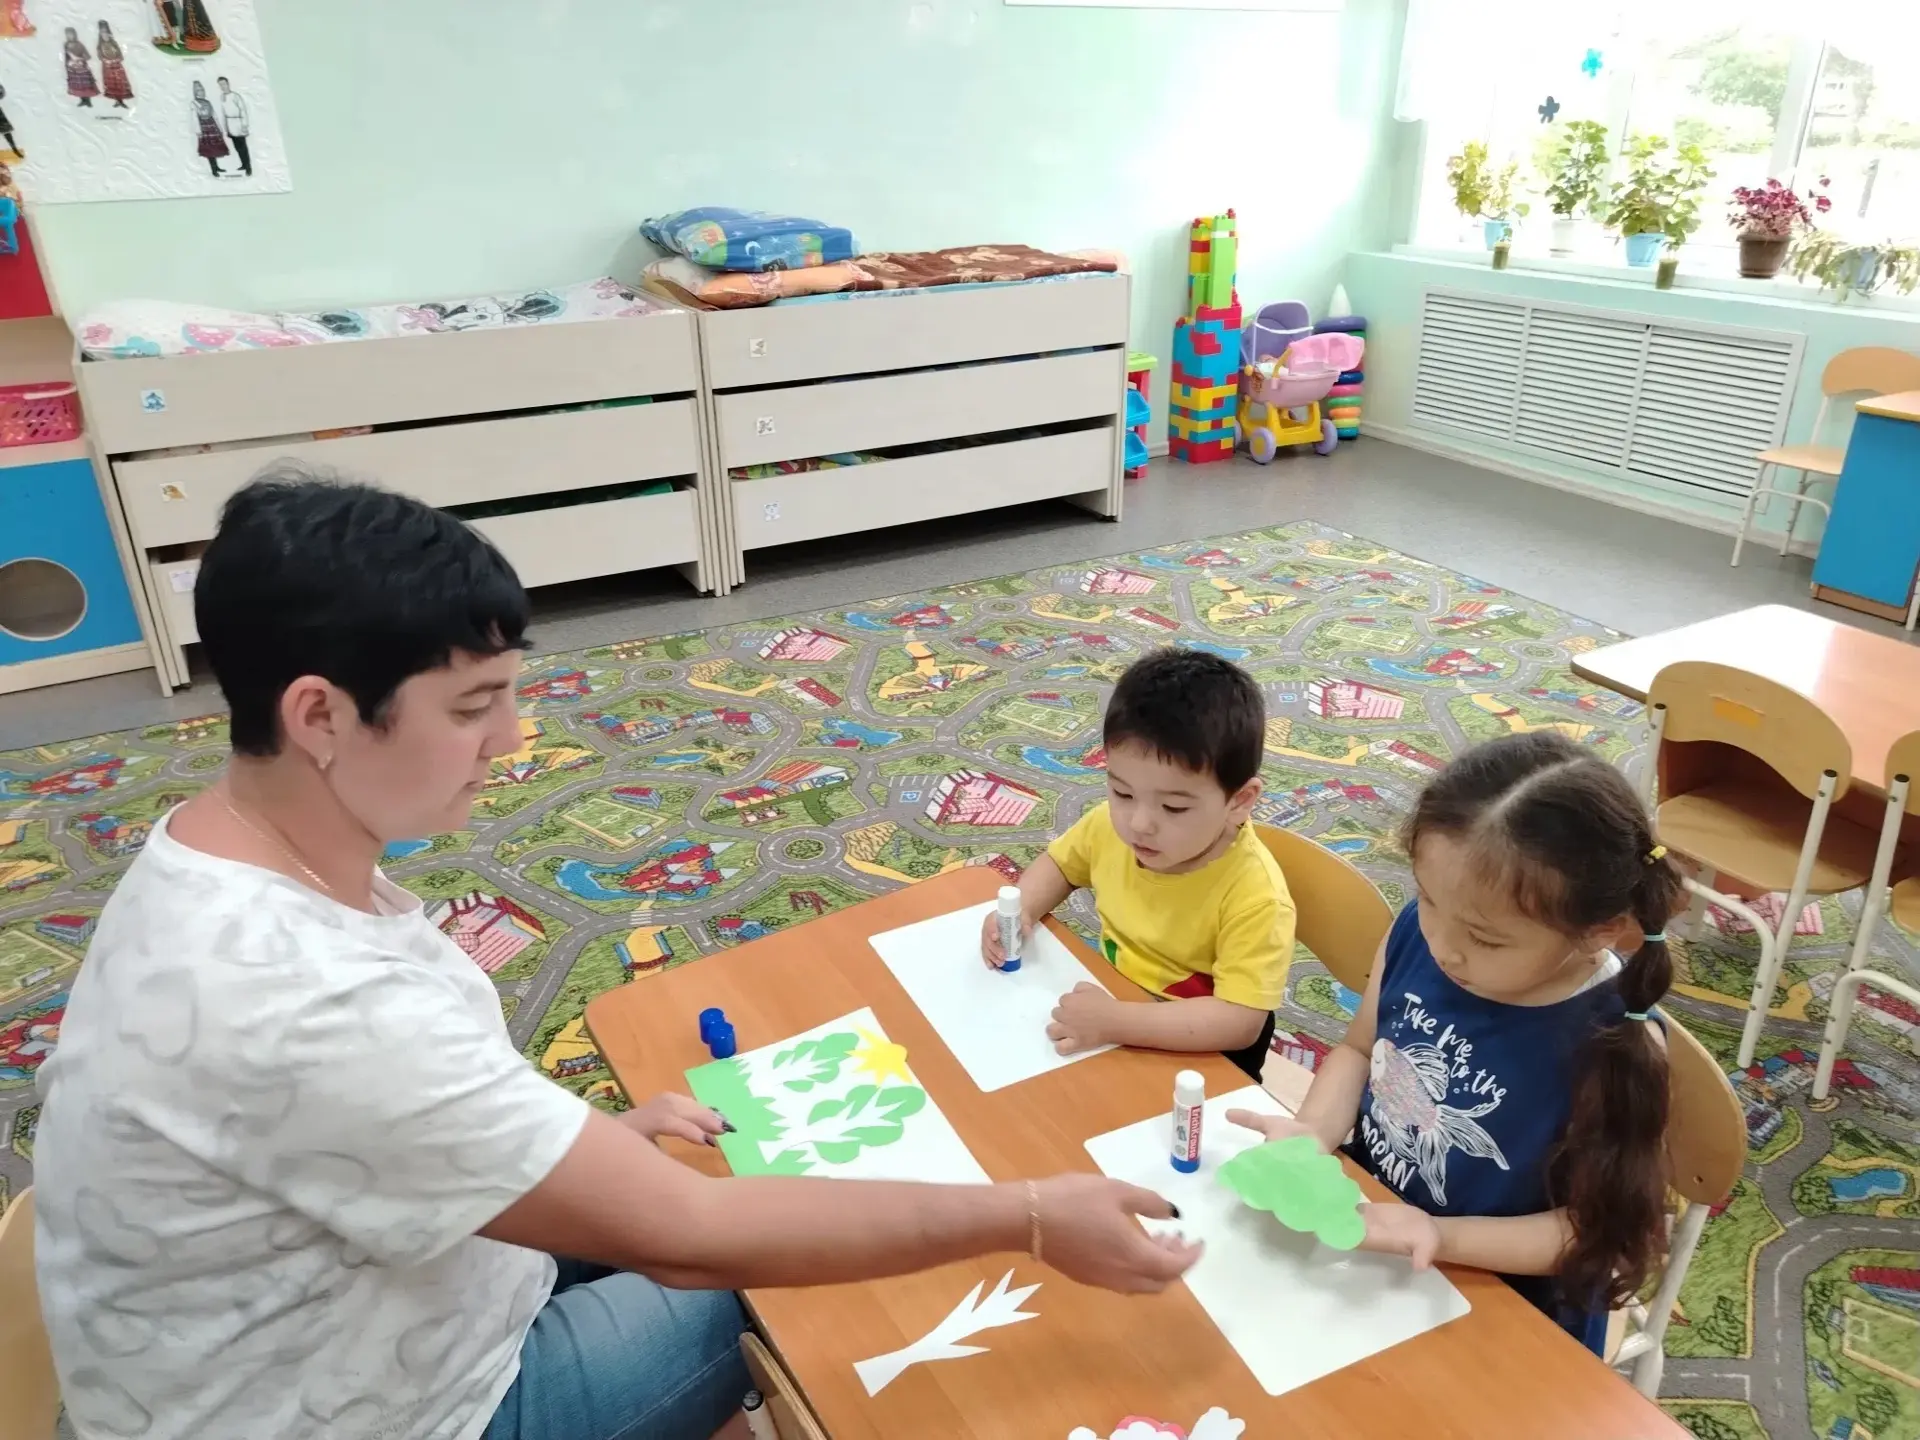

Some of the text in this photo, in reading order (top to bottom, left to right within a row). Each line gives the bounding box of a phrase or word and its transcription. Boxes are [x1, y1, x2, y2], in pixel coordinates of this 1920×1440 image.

[1403, 992, 1437, 1035] Take
[1450, 1056, 1508, 1102] to the
